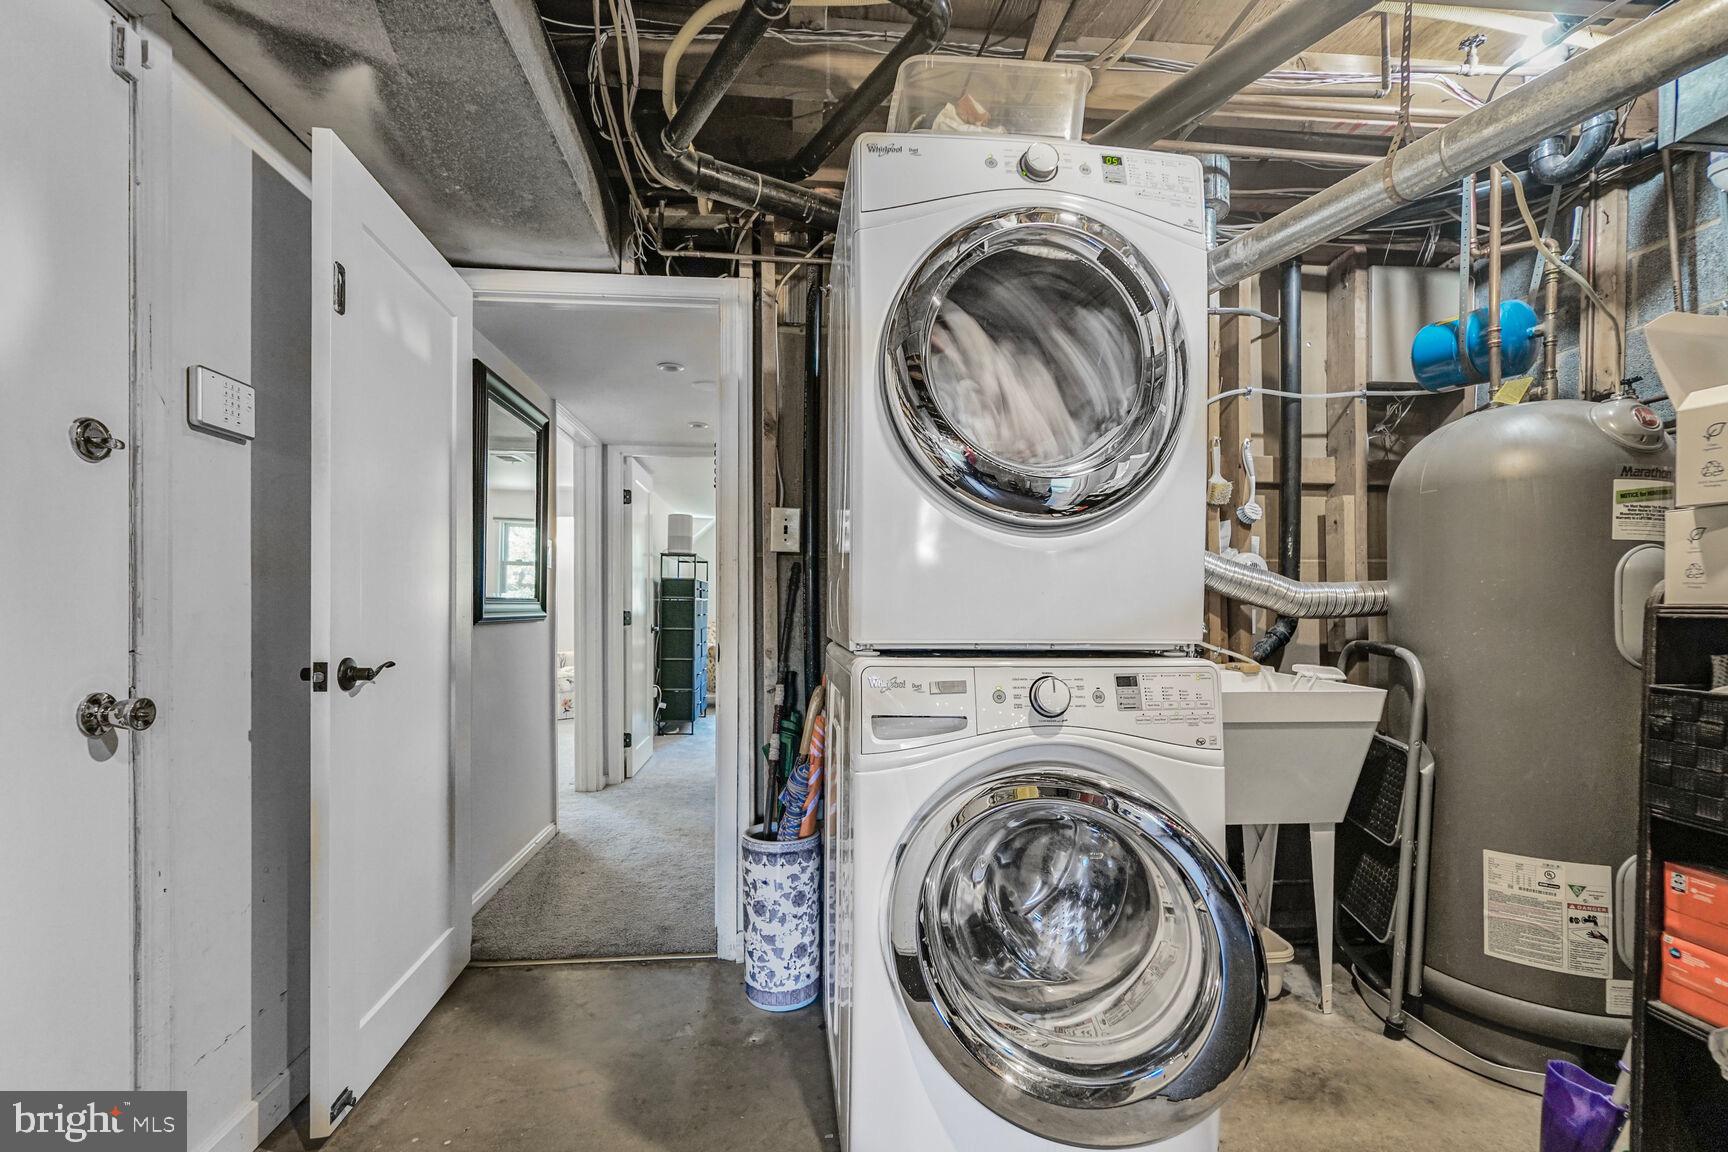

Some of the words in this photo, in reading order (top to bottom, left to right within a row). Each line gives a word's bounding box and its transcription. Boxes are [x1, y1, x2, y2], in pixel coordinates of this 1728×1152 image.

[866, 143, 903, 157] Whirlpool
[1105, 156, 1118, 166] 05
[1620, 466, 1672, 479] Marathon
[1620, 491, 1639, 499] NOTICE
[867, 676, 906, 693] Whirlpool
